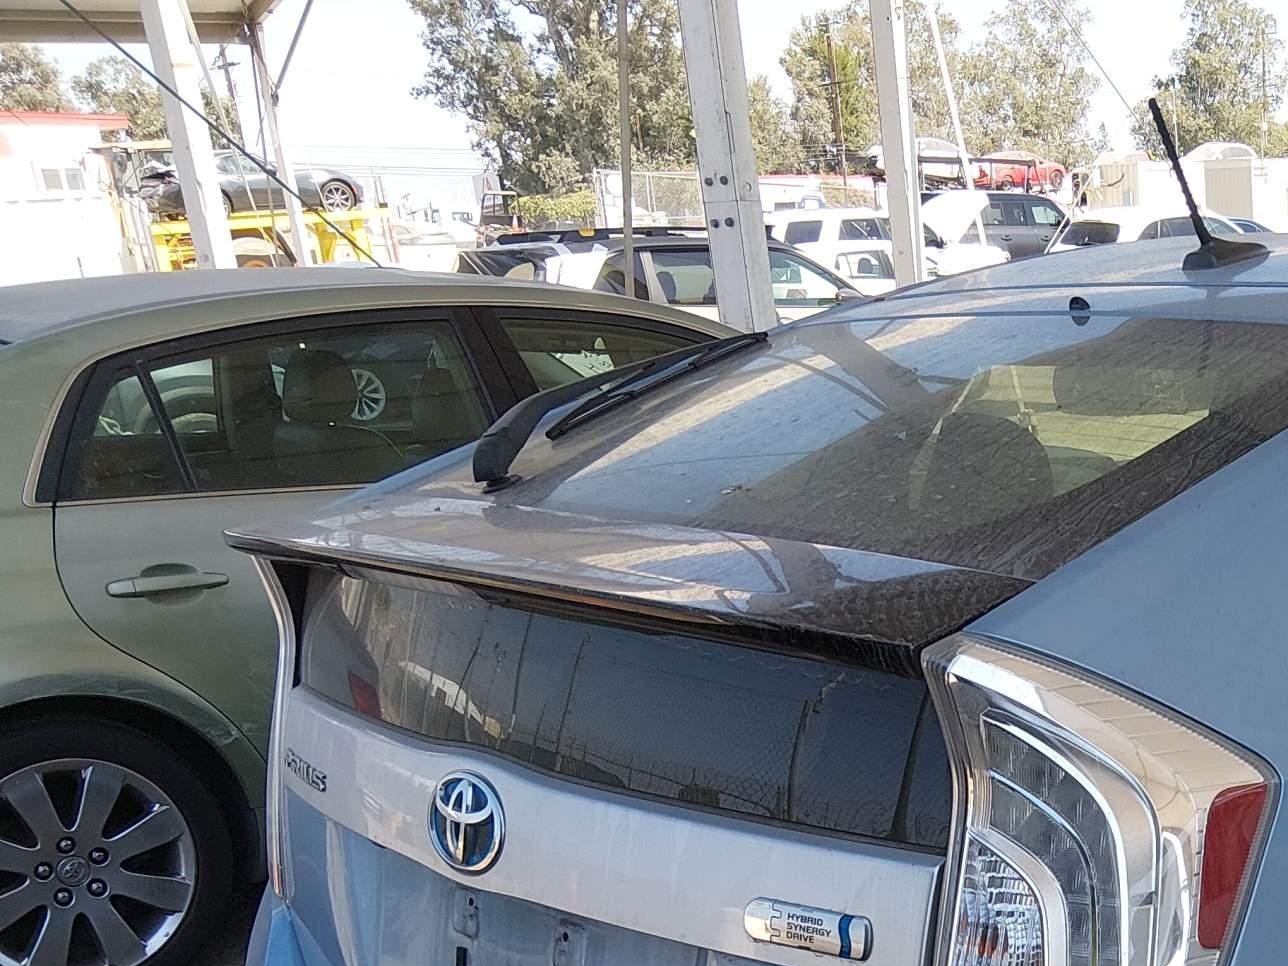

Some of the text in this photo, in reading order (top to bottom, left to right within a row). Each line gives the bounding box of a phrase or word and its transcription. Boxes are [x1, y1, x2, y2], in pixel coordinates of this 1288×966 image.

[787, 912, 824, 927] HYBRID
[786, 921, 832, 937] SYNERGY
[786, 931, 815, 944] DRIVE
